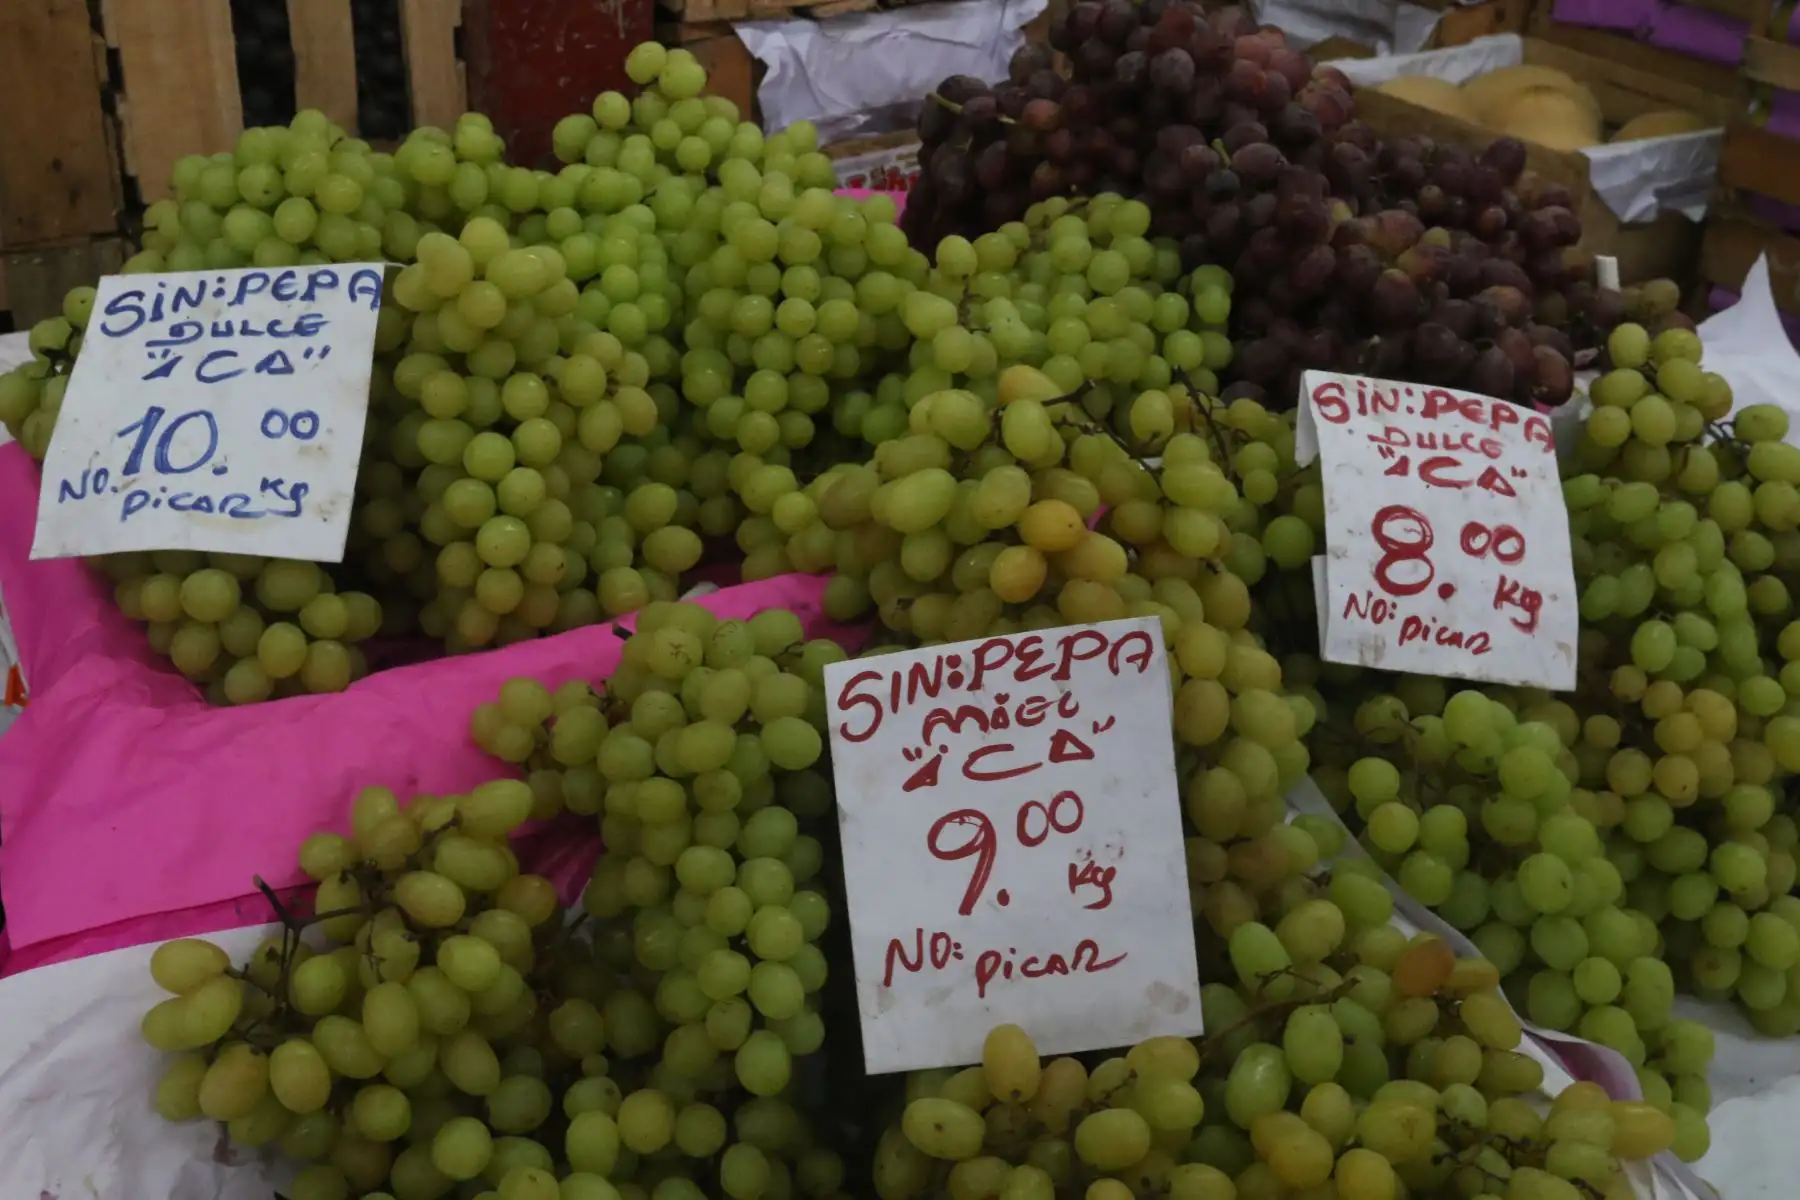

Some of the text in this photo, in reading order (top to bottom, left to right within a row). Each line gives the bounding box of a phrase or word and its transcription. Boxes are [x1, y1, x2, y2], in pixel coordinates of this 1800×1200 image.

[144, 312, 332, 348] DULCE
[1367, 425, 1505, 459] DULCE
[1493, 573, 1544, 634] Kg
[1067, 859, 1117, 910] Kg
